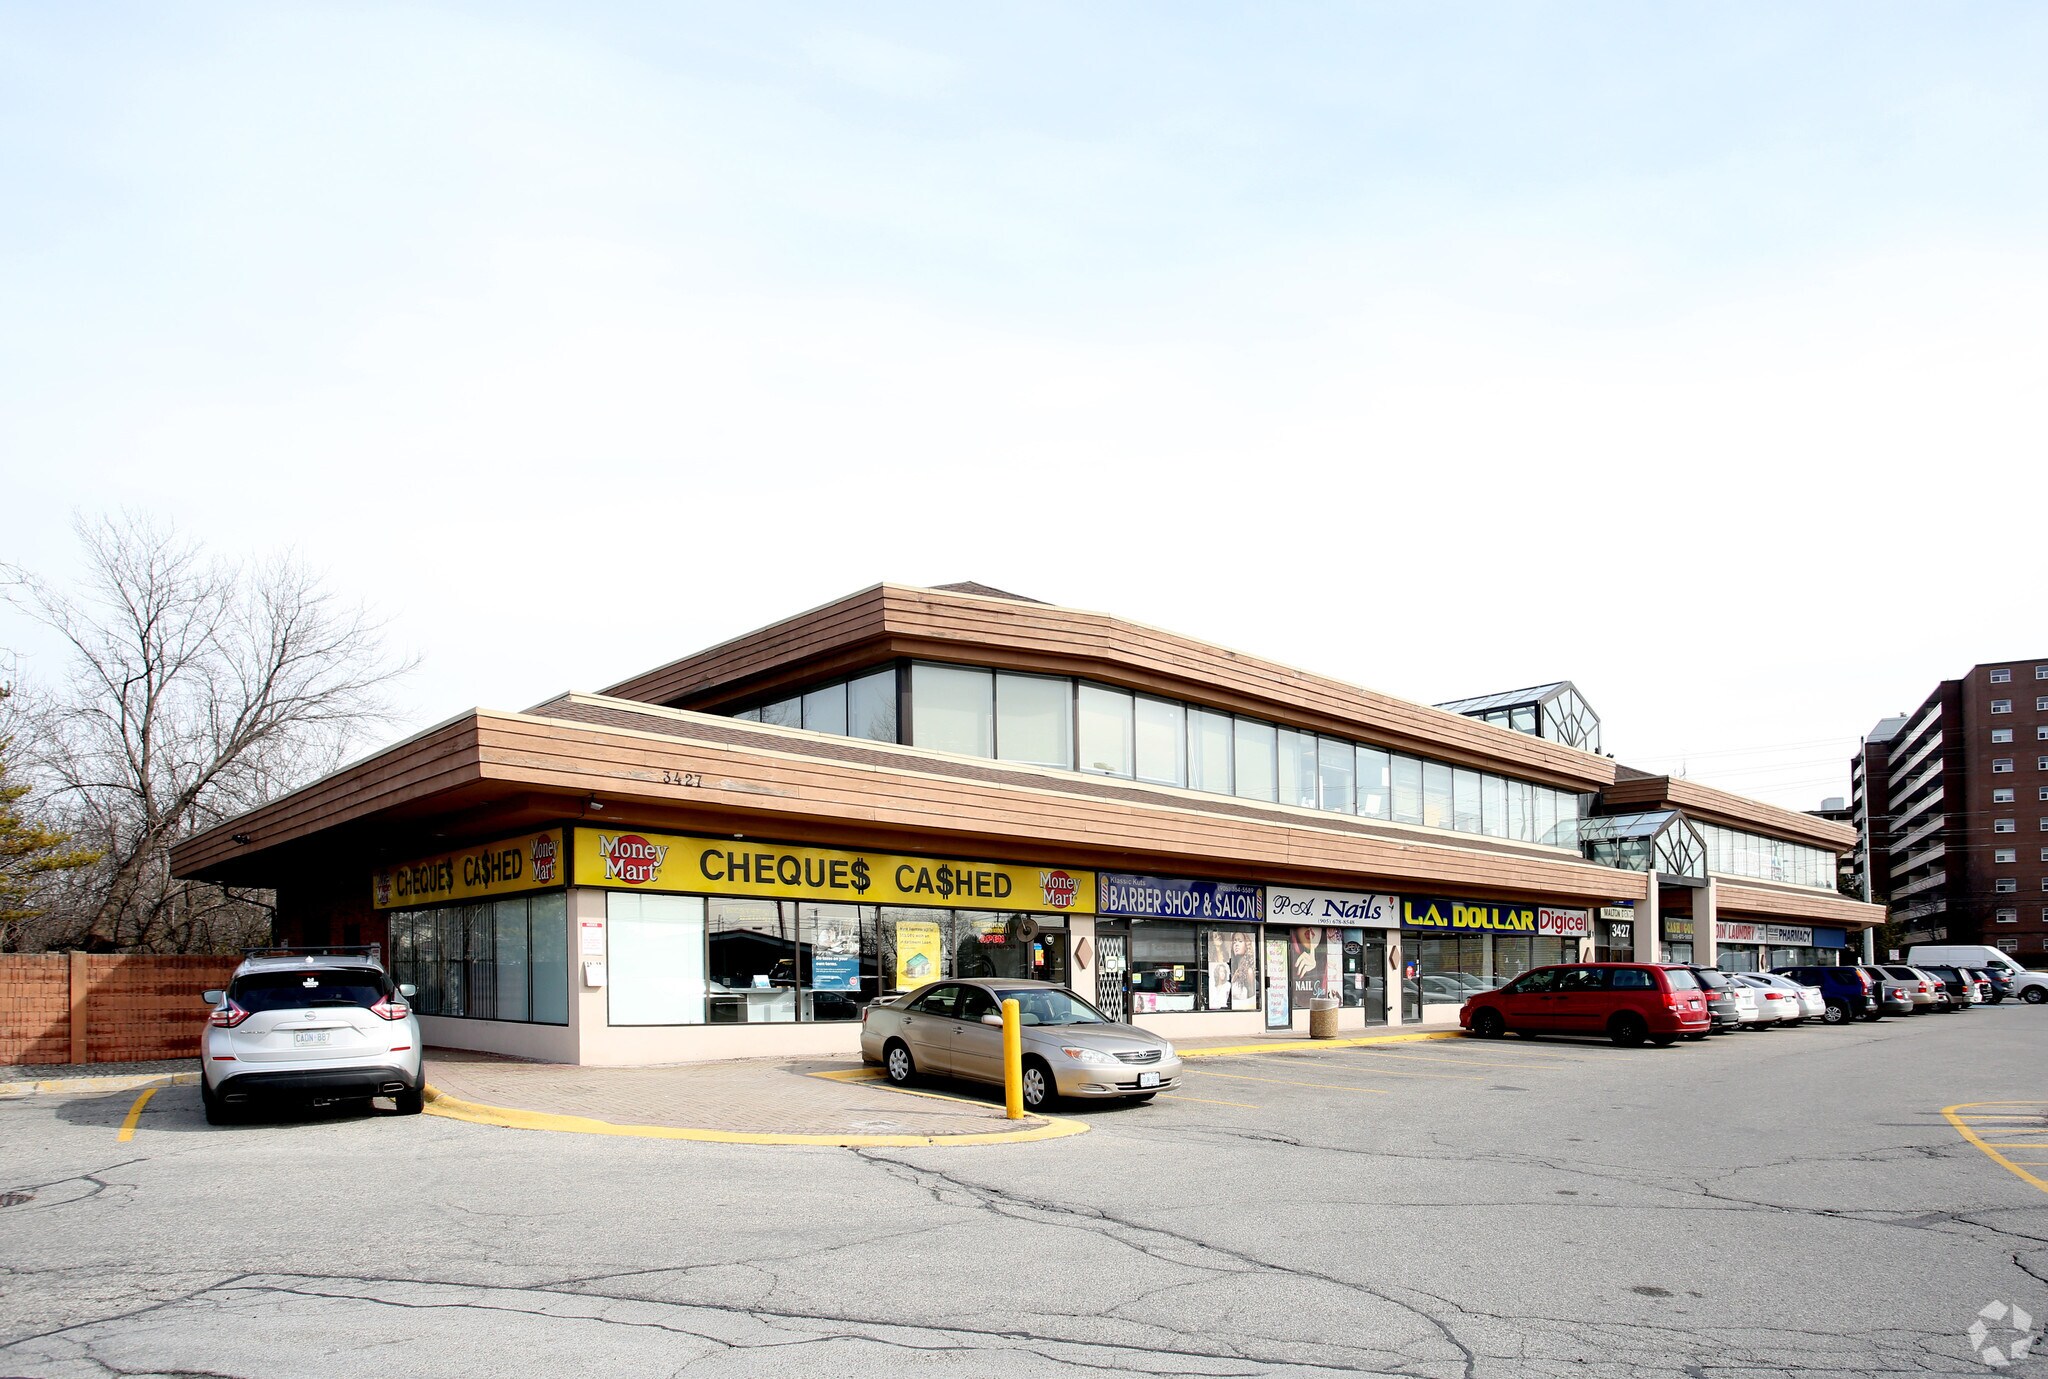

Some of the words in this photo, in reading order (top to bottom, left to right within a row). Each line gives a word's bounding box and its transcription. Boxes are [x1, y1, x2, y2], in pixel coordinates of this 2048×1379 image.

[662, 769, 703, 788] 3427
[530, 838, 560, 861] Money
[598, 834, 669, 867] Money
[396, 857, 454, 897] CHEQUE$
[463, 848, 523, 889] CA$HED
[532, 858, 557, 882] Mart
[604, 856, 658, 883] Mart
[700, 848, 871, 895] CHEQUE$
[895, 863, 1012, 900] CA$HED
[1110, 876, 1132, 885] Klassic
[1039, 870, 1082, 895] Money
[1042, 888, 1075, 907] Mart
[1110, 886, 1161, 914] BARBER
[1164, 890, 1200, 916] SHOP
[1203, 894, 1213, 917] &
[1215, 894, 1255, 919] SALON
[1322, 894, 1382, 920] Nails
[1404, 901, 1448, 927] L.A.
[1452, 905, 1536, 931] DOLLAR
[1539, 909, 1587, 935] Digicel
[1666, 921, 1681, 933] CASH
[1684, 923, 1693, 934] GOL
[1611, 923, 1630, 938] 3427
[1728, 923, 1755, 941] LAUNDRY
[1778, 928, 1811, 943] PHARMACY
[1295, 980, 1313, 991] NAIL
